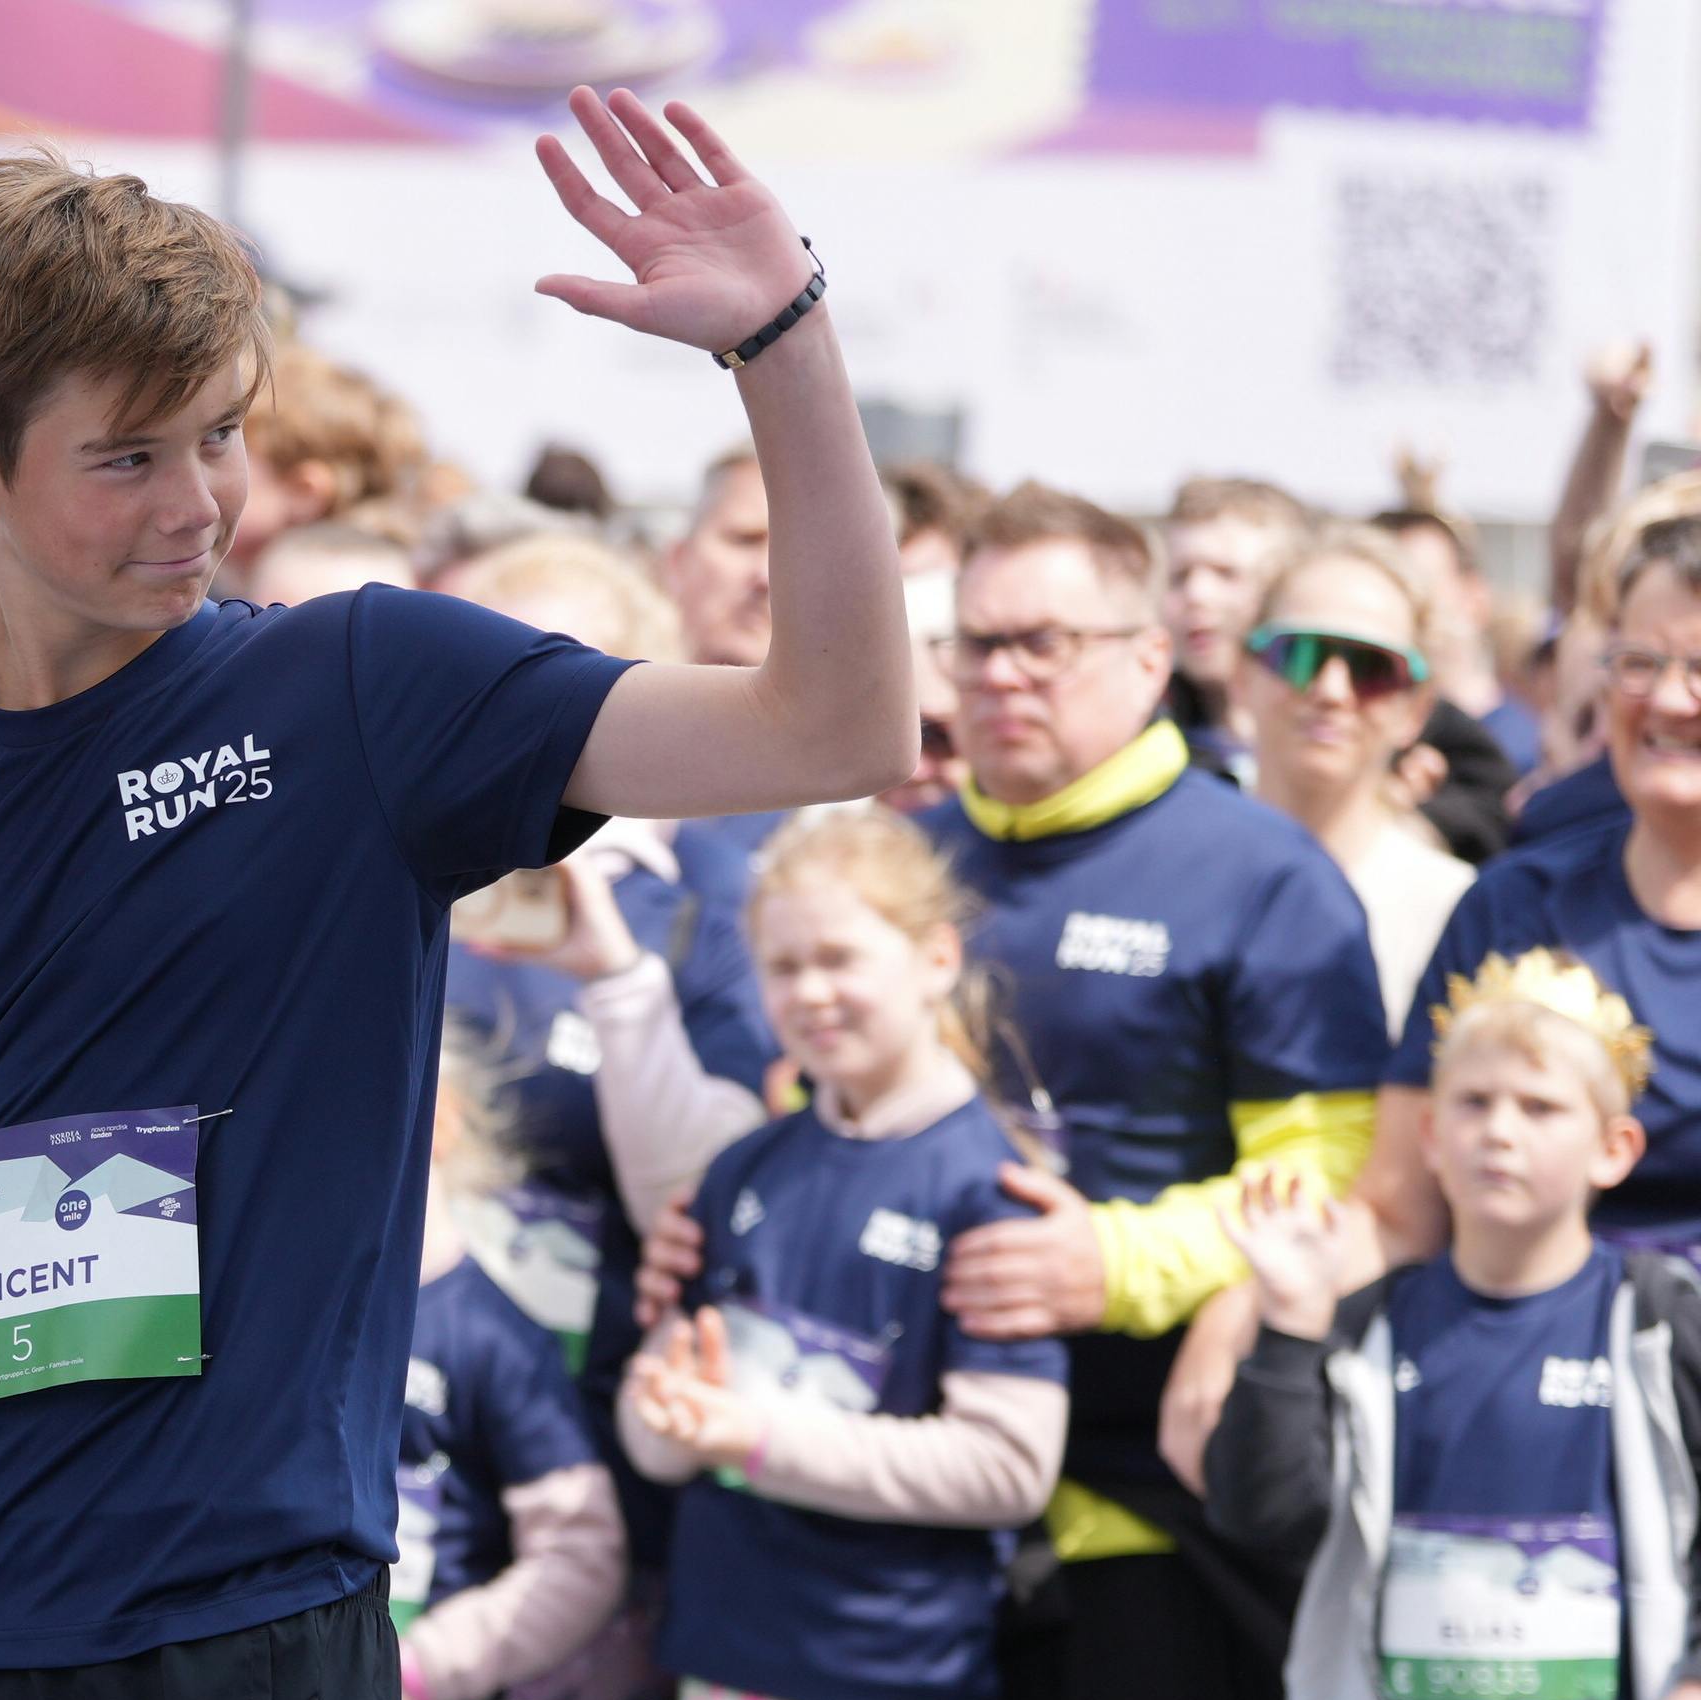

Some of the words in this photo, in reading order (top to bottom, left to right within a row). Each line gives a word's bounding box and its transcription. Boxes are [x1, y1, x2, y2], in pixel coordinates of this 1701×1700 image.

[117, 734, 271, 806] ROYAL
[124, 780, 217, 842] RUN
[135, 1125, 180, 1134] TrygFonden
[59, 1199, 88, 1213] one
[63, 1211, 82, 1222] mile
[12, 1323, 33, 1362] 5
